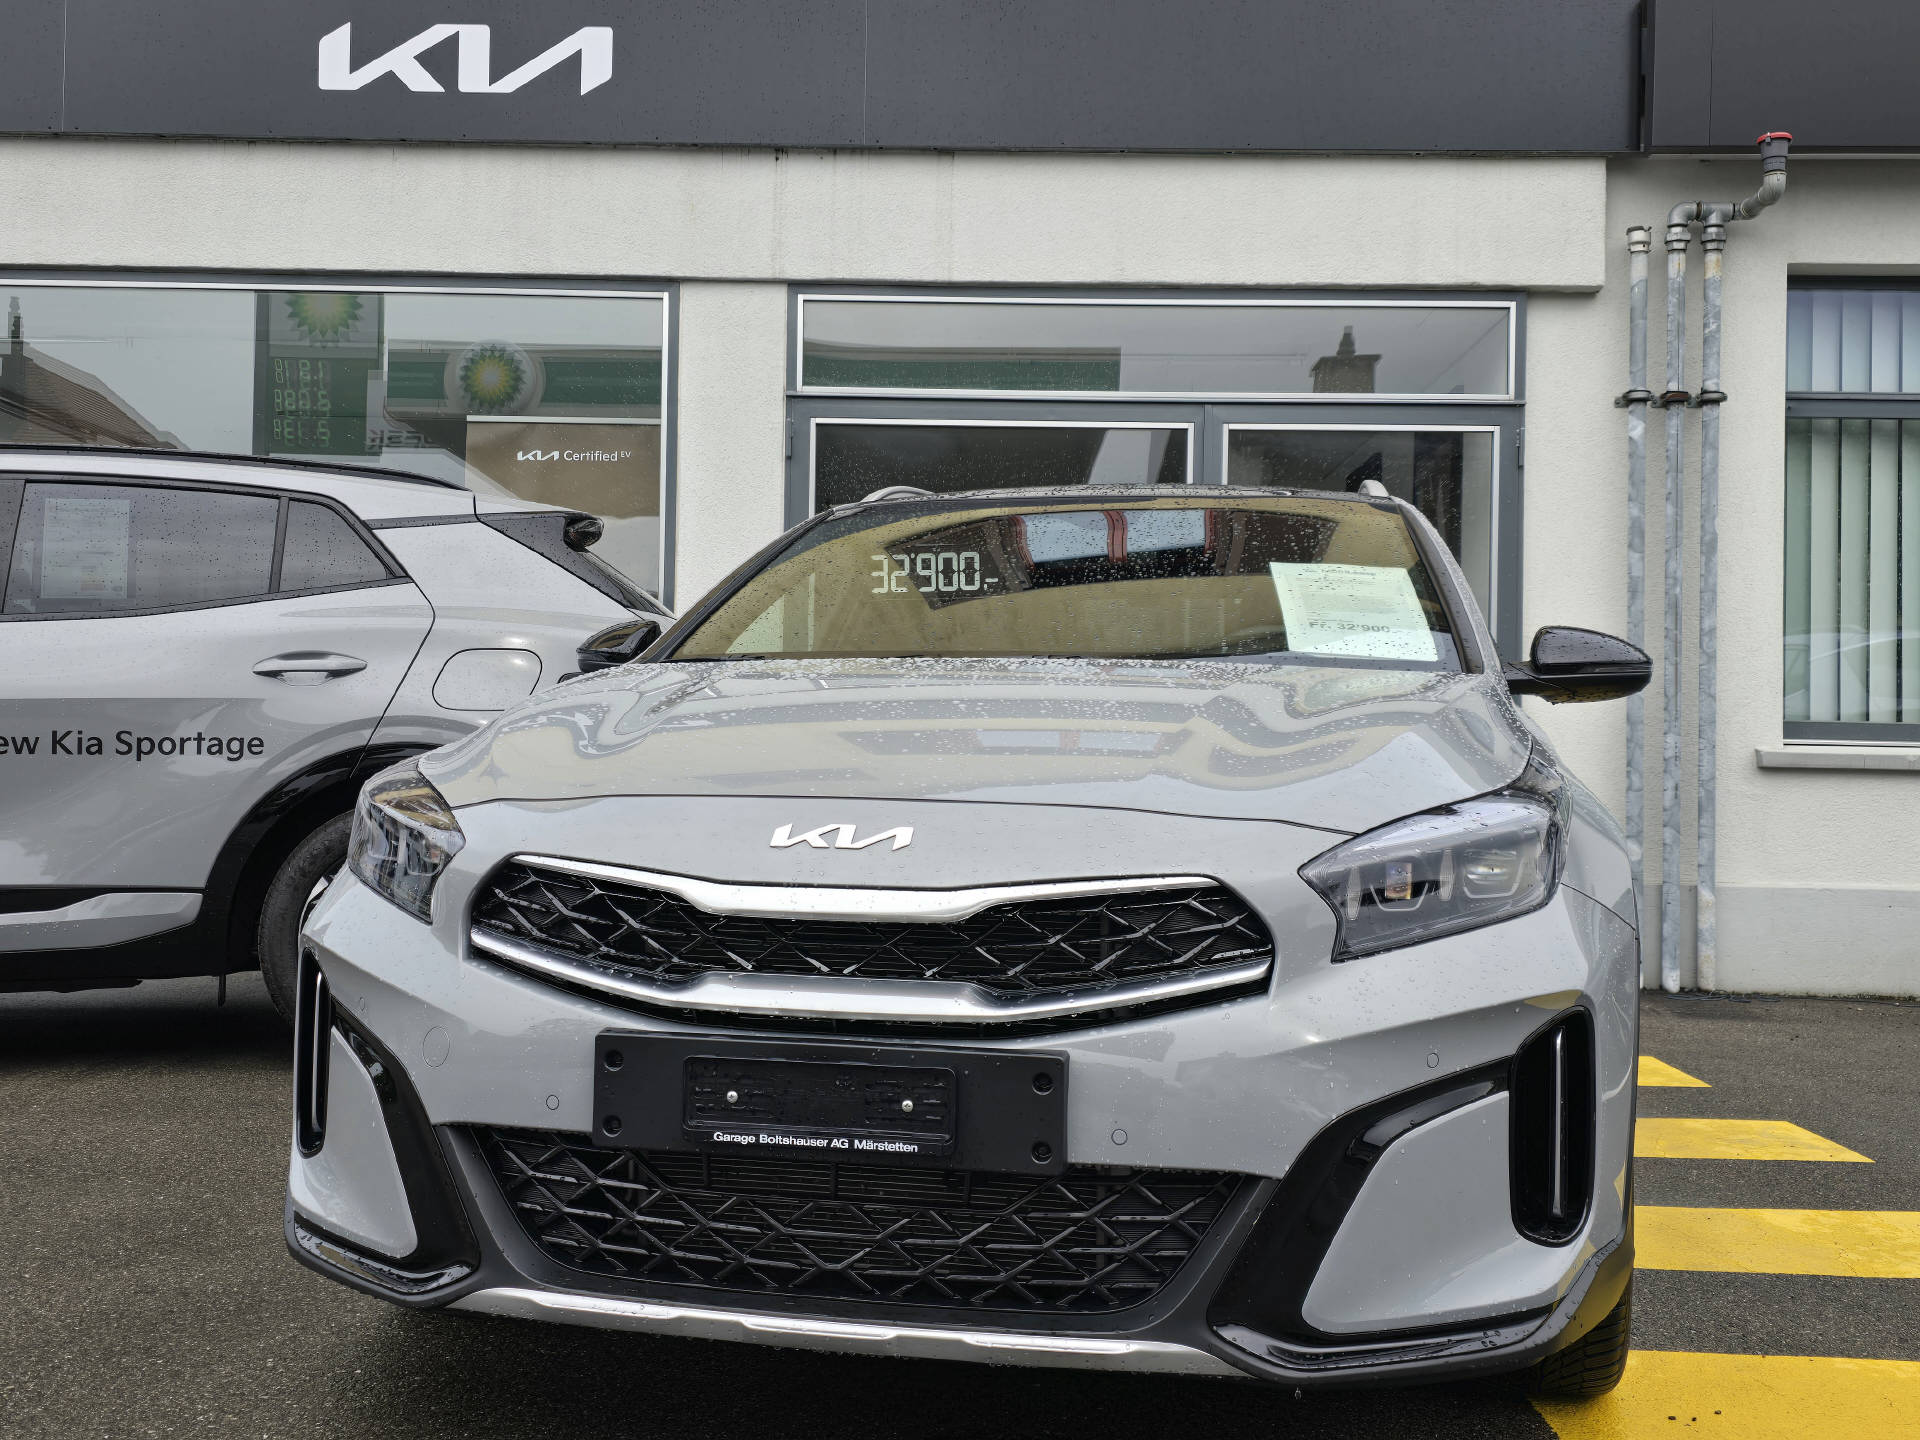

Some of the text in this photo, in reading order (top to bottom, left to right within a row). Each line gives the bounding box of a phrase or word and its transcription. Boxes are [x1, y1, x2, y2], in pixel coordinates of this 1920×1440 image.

[563, 450, 618, 462] Certified
[51, 730, 103, 756] Kia
[115, 730, 265, 762] Sportage
[713, 1131, 918, 1153] Garage Boltshauser AG Märstetten
